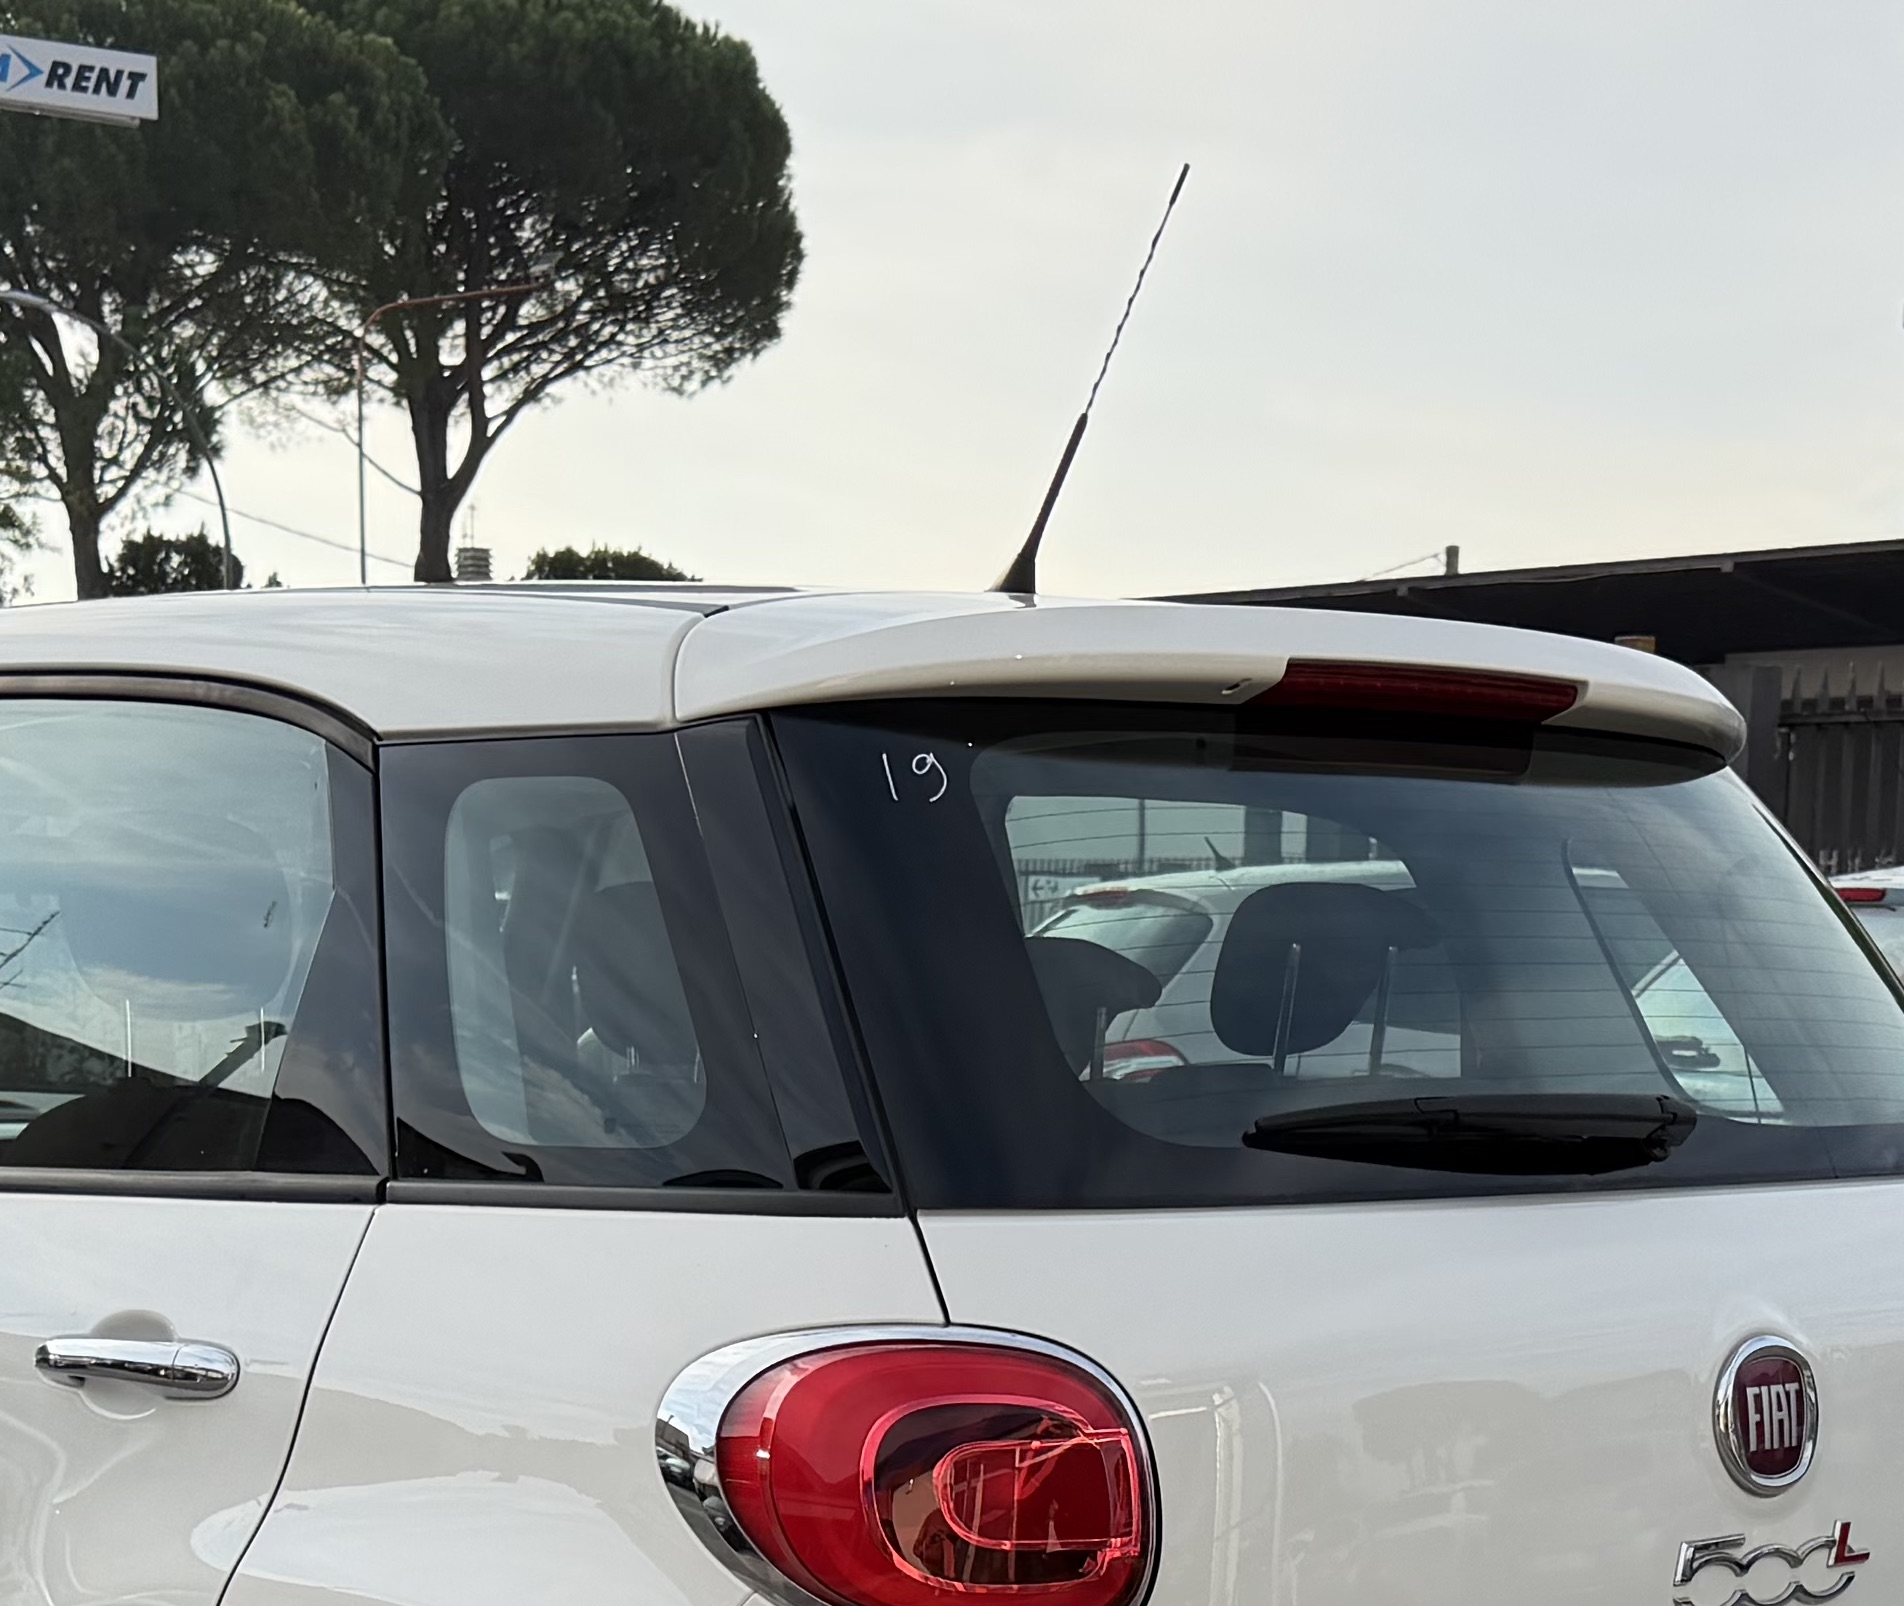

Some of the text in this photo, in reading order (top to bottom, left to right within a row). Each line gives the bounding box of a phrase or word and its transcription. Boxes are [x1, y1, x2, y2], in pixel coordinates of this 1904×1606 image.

[45, 60, 147, 100] RENT
[882, 752, 947, 802] 19
[1746, 1382, 1800, 1451] FIAT
